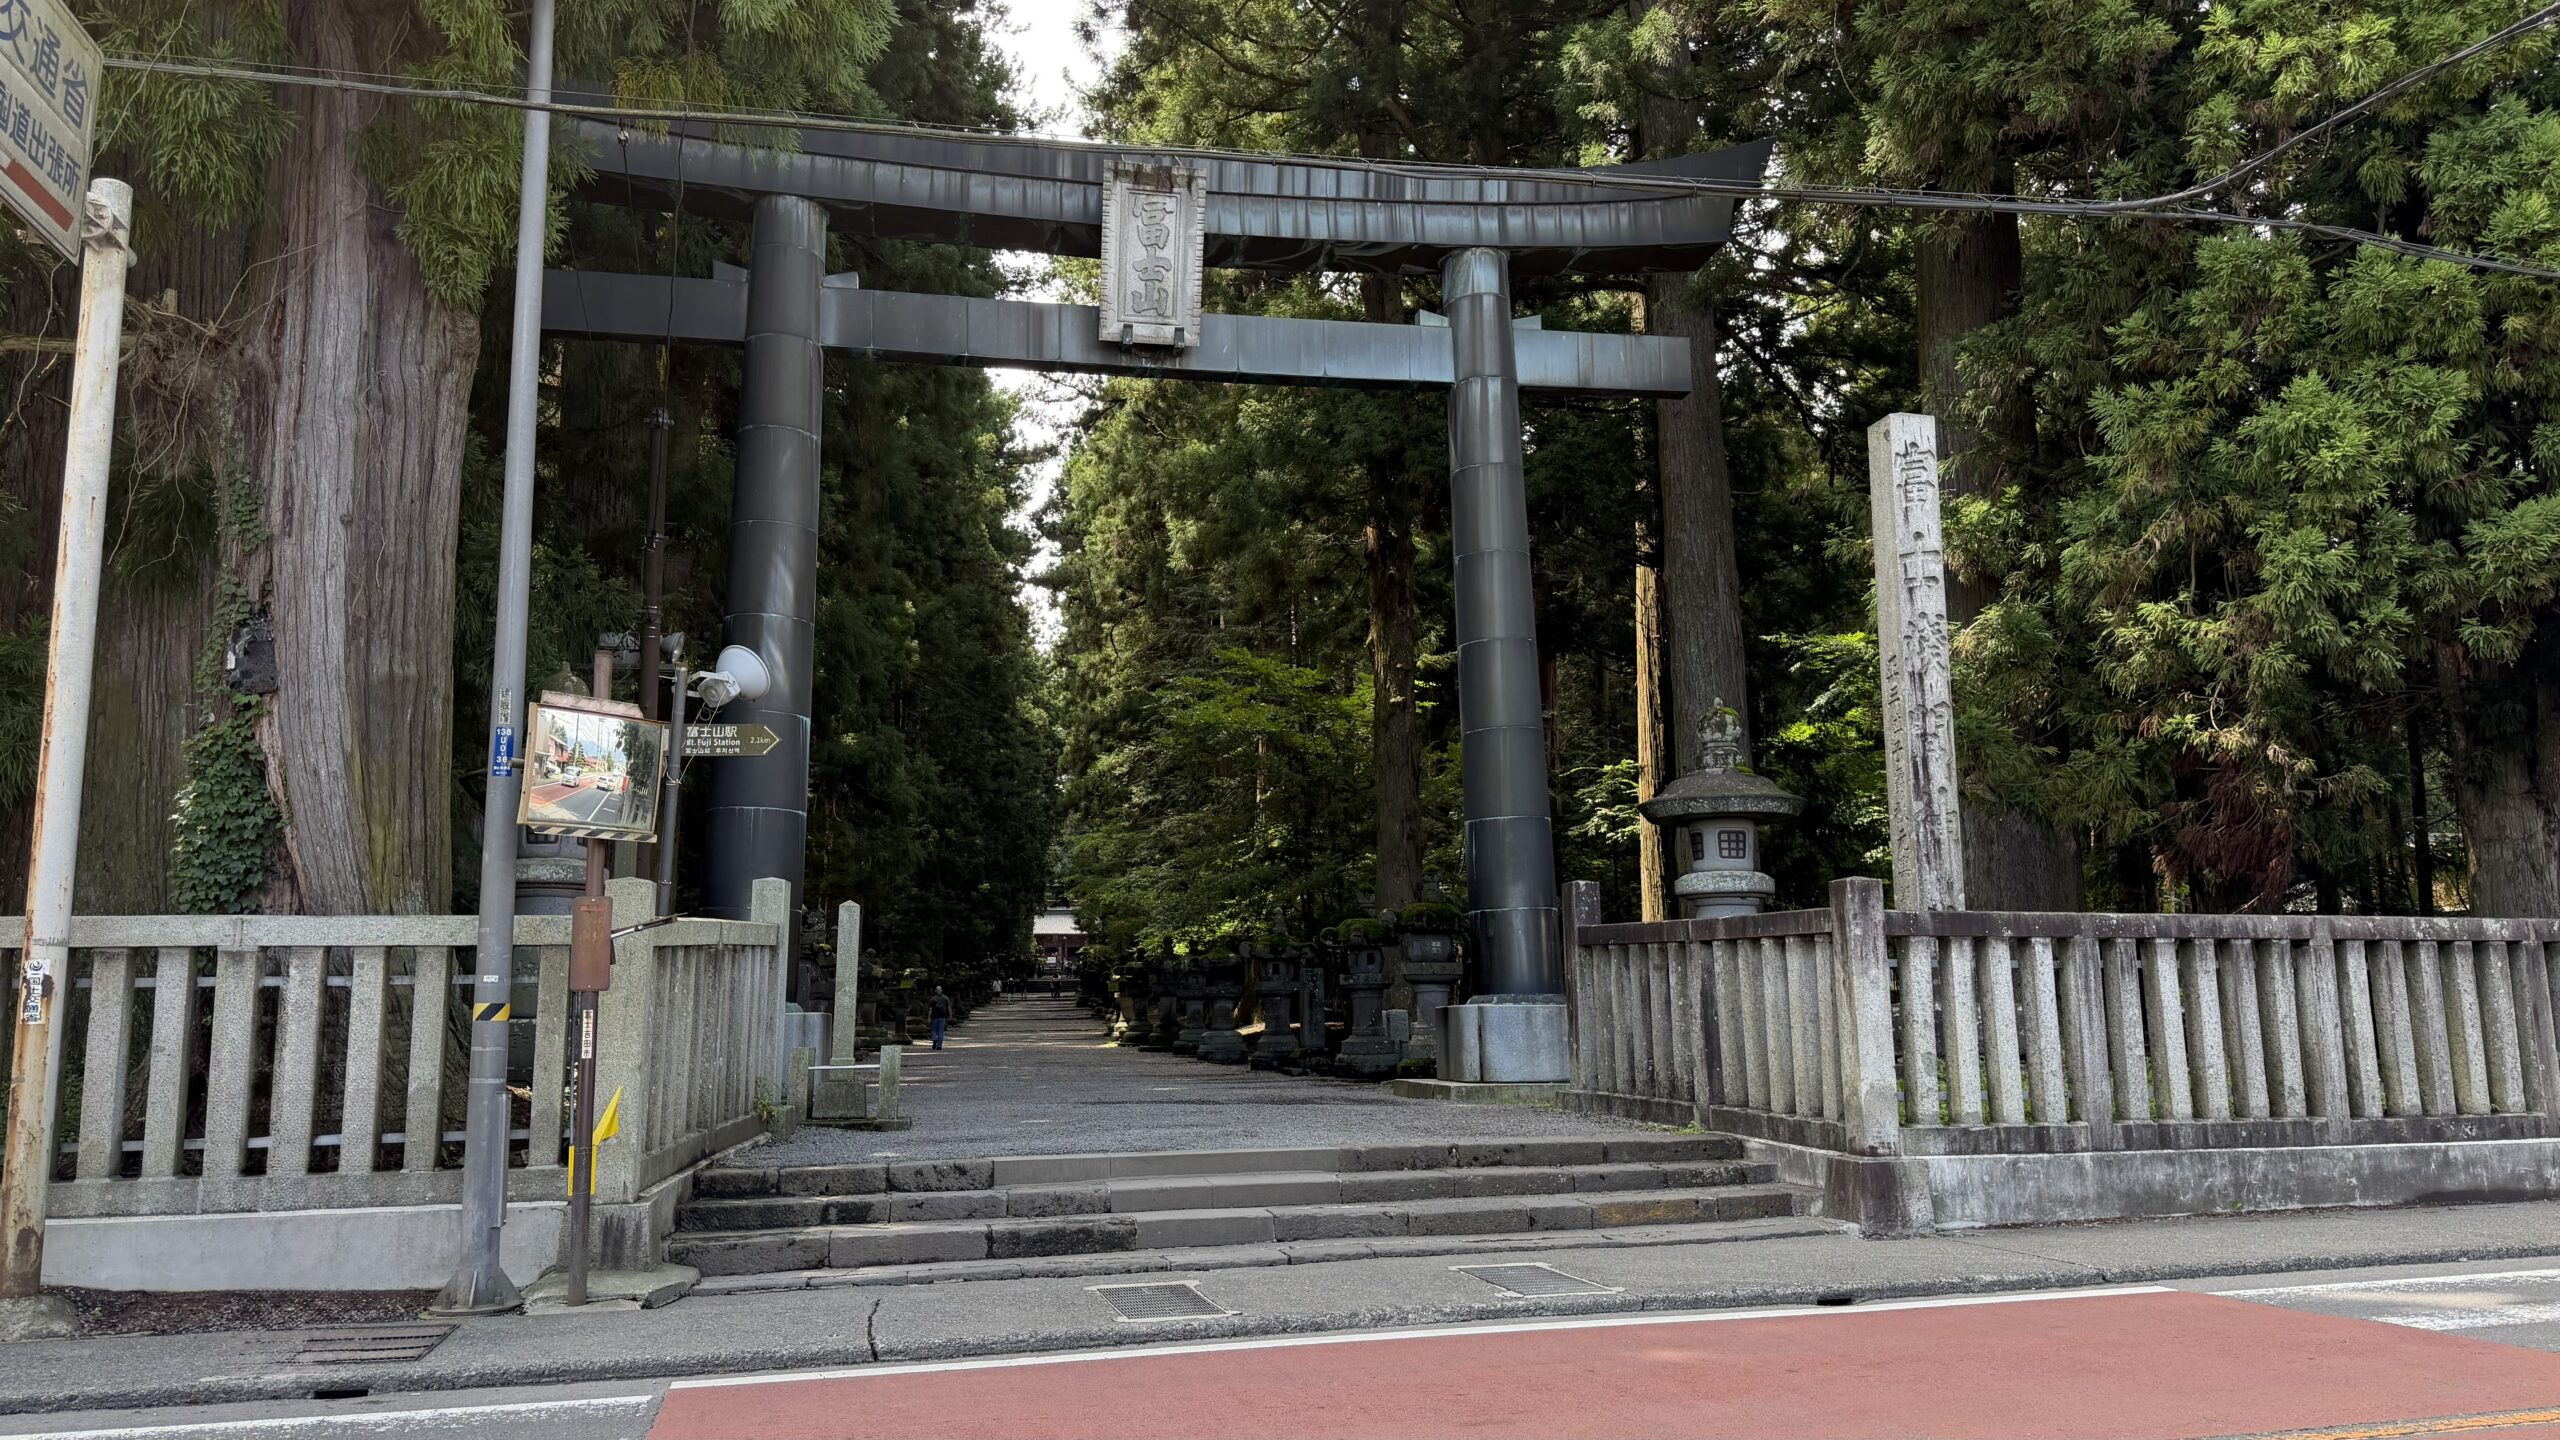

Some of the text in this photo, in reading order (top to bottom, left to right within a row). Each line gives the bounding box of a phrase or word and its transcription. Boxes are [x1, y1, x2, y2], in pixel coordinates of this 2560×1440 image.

[496, 728, 512, 736] 138
[686, 725, 738, 738] 富士山駅
[697, 738, 712, 747] Fuji
[713, 738, 741, 746] Station
[583, 1010, 592, 1057] 富士吉田市
